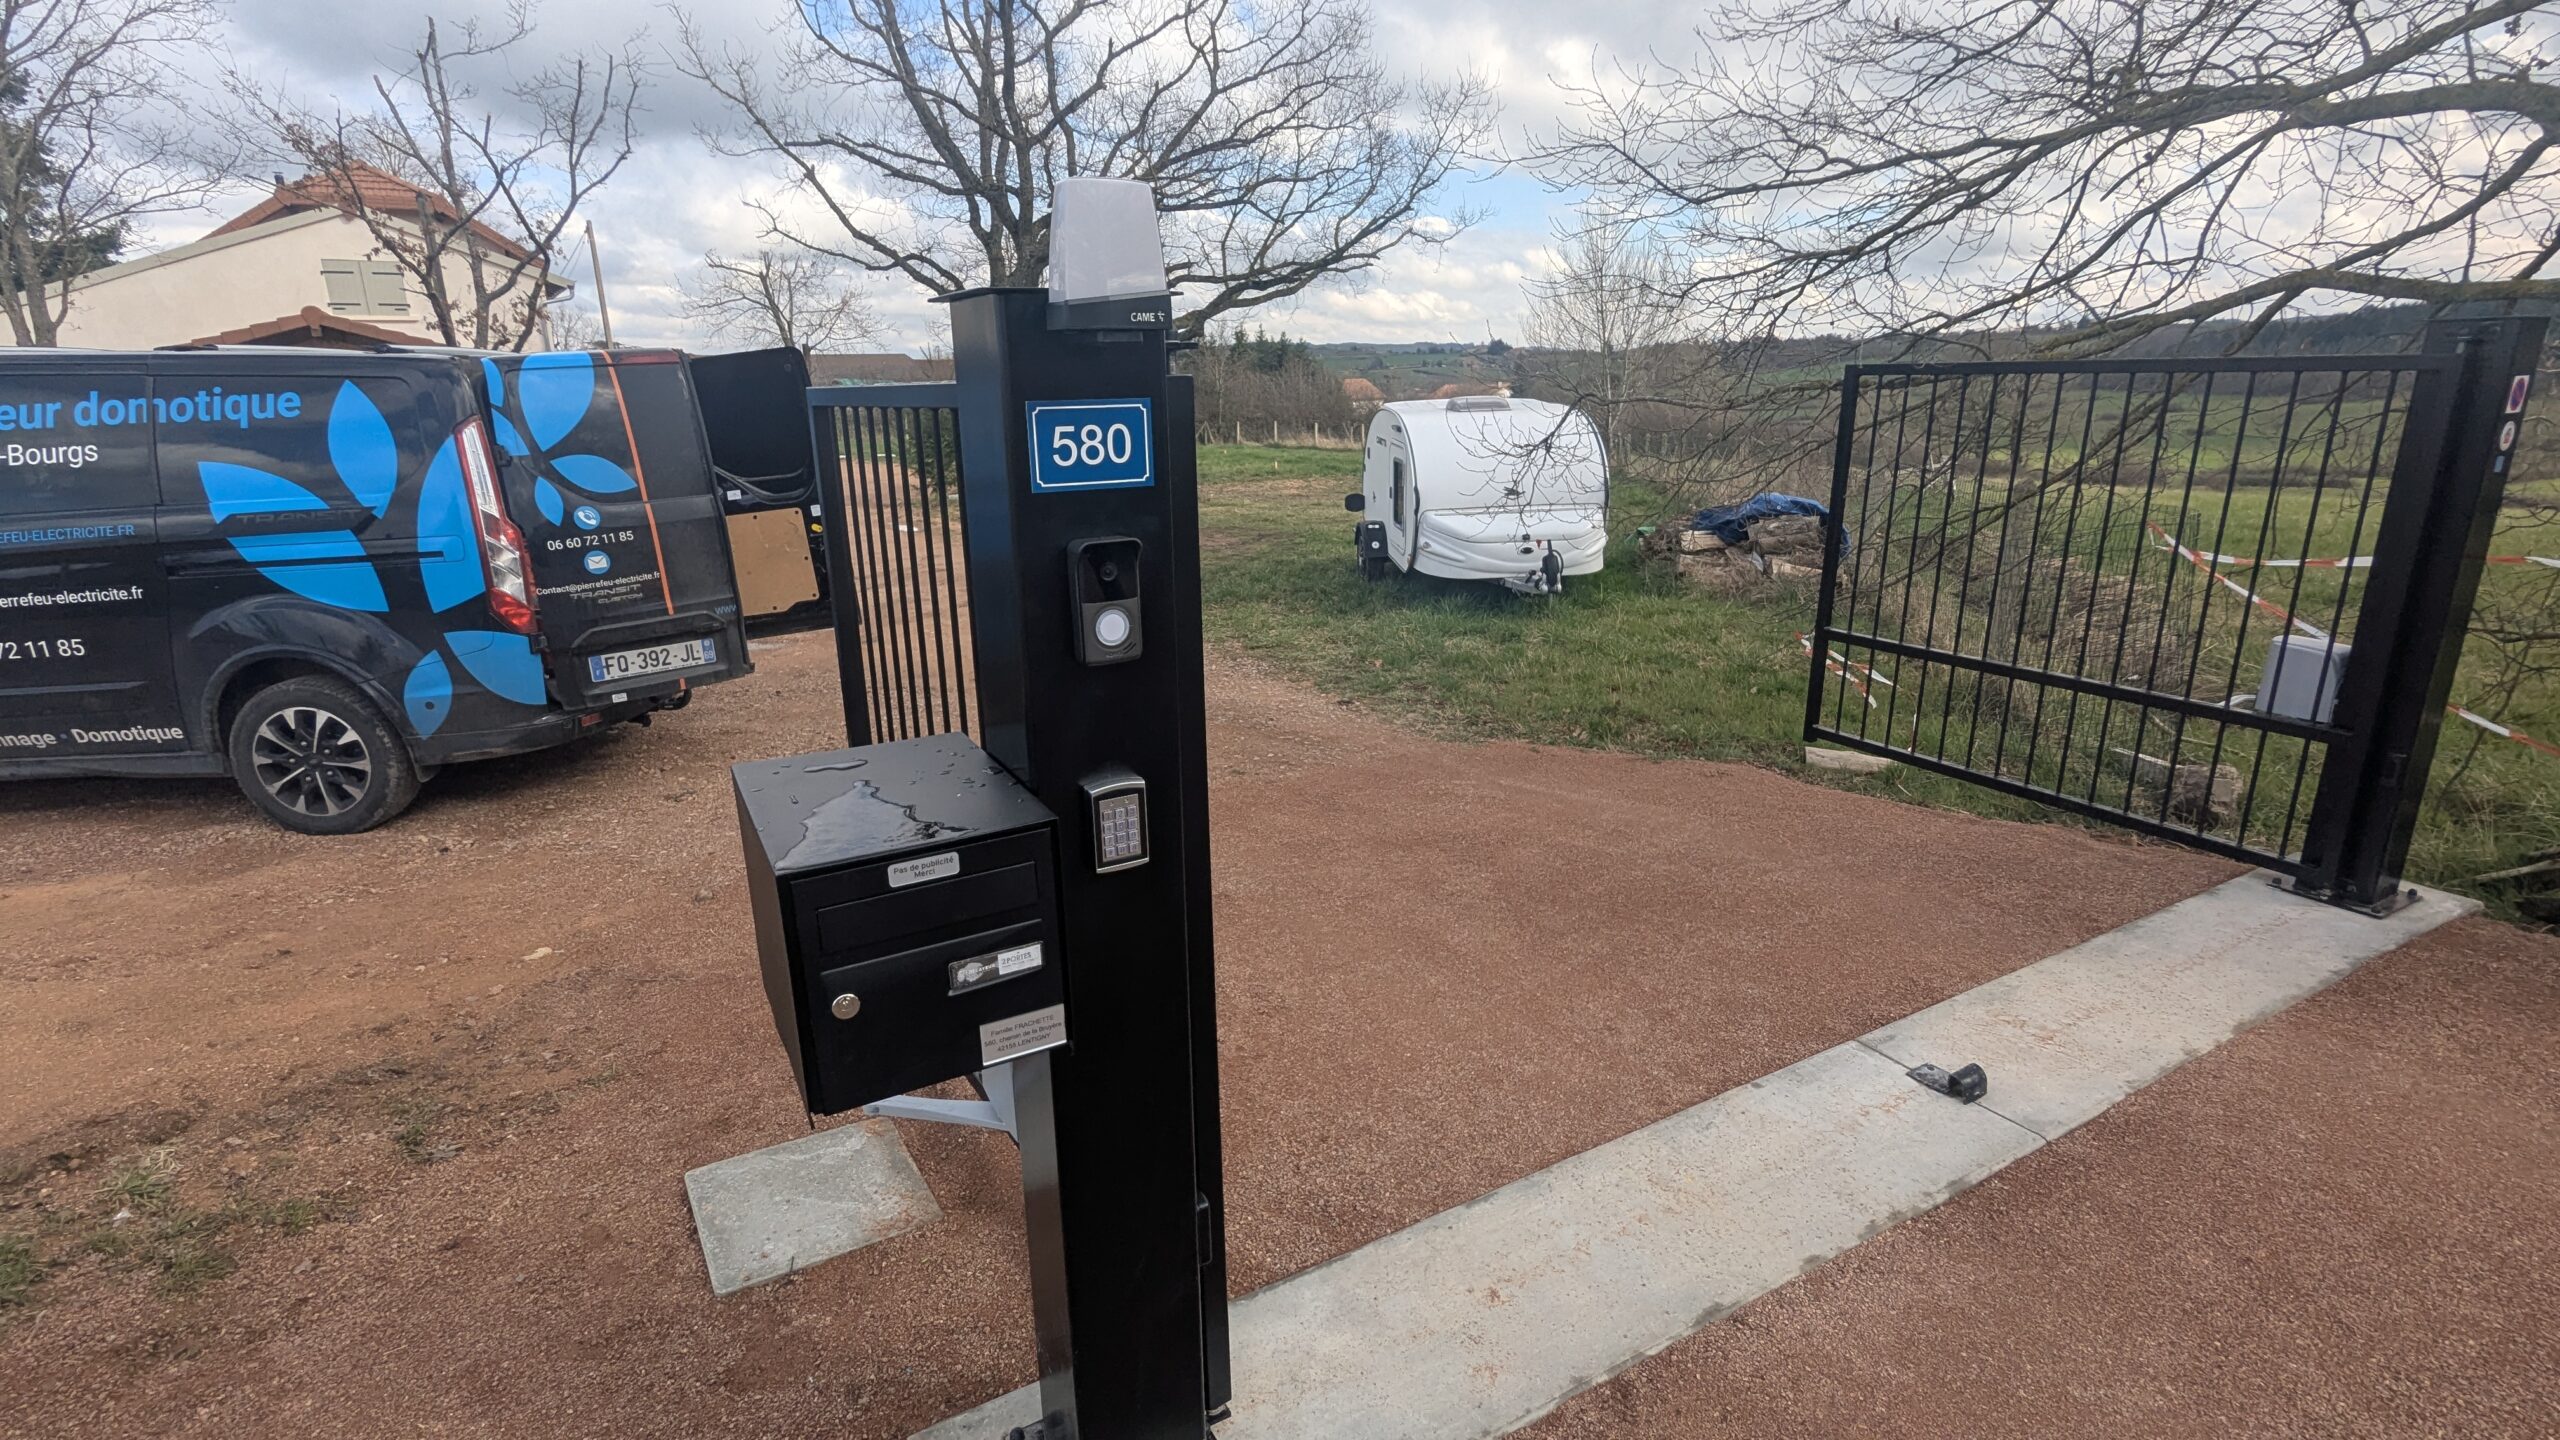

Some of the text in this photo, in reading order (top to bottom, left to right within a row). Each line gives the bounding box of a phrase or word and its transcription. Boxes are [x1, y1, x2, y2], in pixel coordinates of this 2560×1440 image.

[1130, 312, 1155, 322] CAME
[74, 386, 302, 429] domotique
[1052, 423, 1132, 467] 580
[546, 530, 634, 551] 06 60 72 11 85
[535, 571, 661, 596] Contact@pierrefeu-electricite.fr
[569, 584, 641, 600] TRANSIT
[25, 640, 50, 658] 11
[57, 638, 86, 657] 85
[703, 650, 714, 660] 69
[604, 643, 701, 676] FQ-392-JL
[71, 725, 184, 743] Domotique
[921, 856, 954, 870] publicité
[914, 868, 935, 878] Merci
